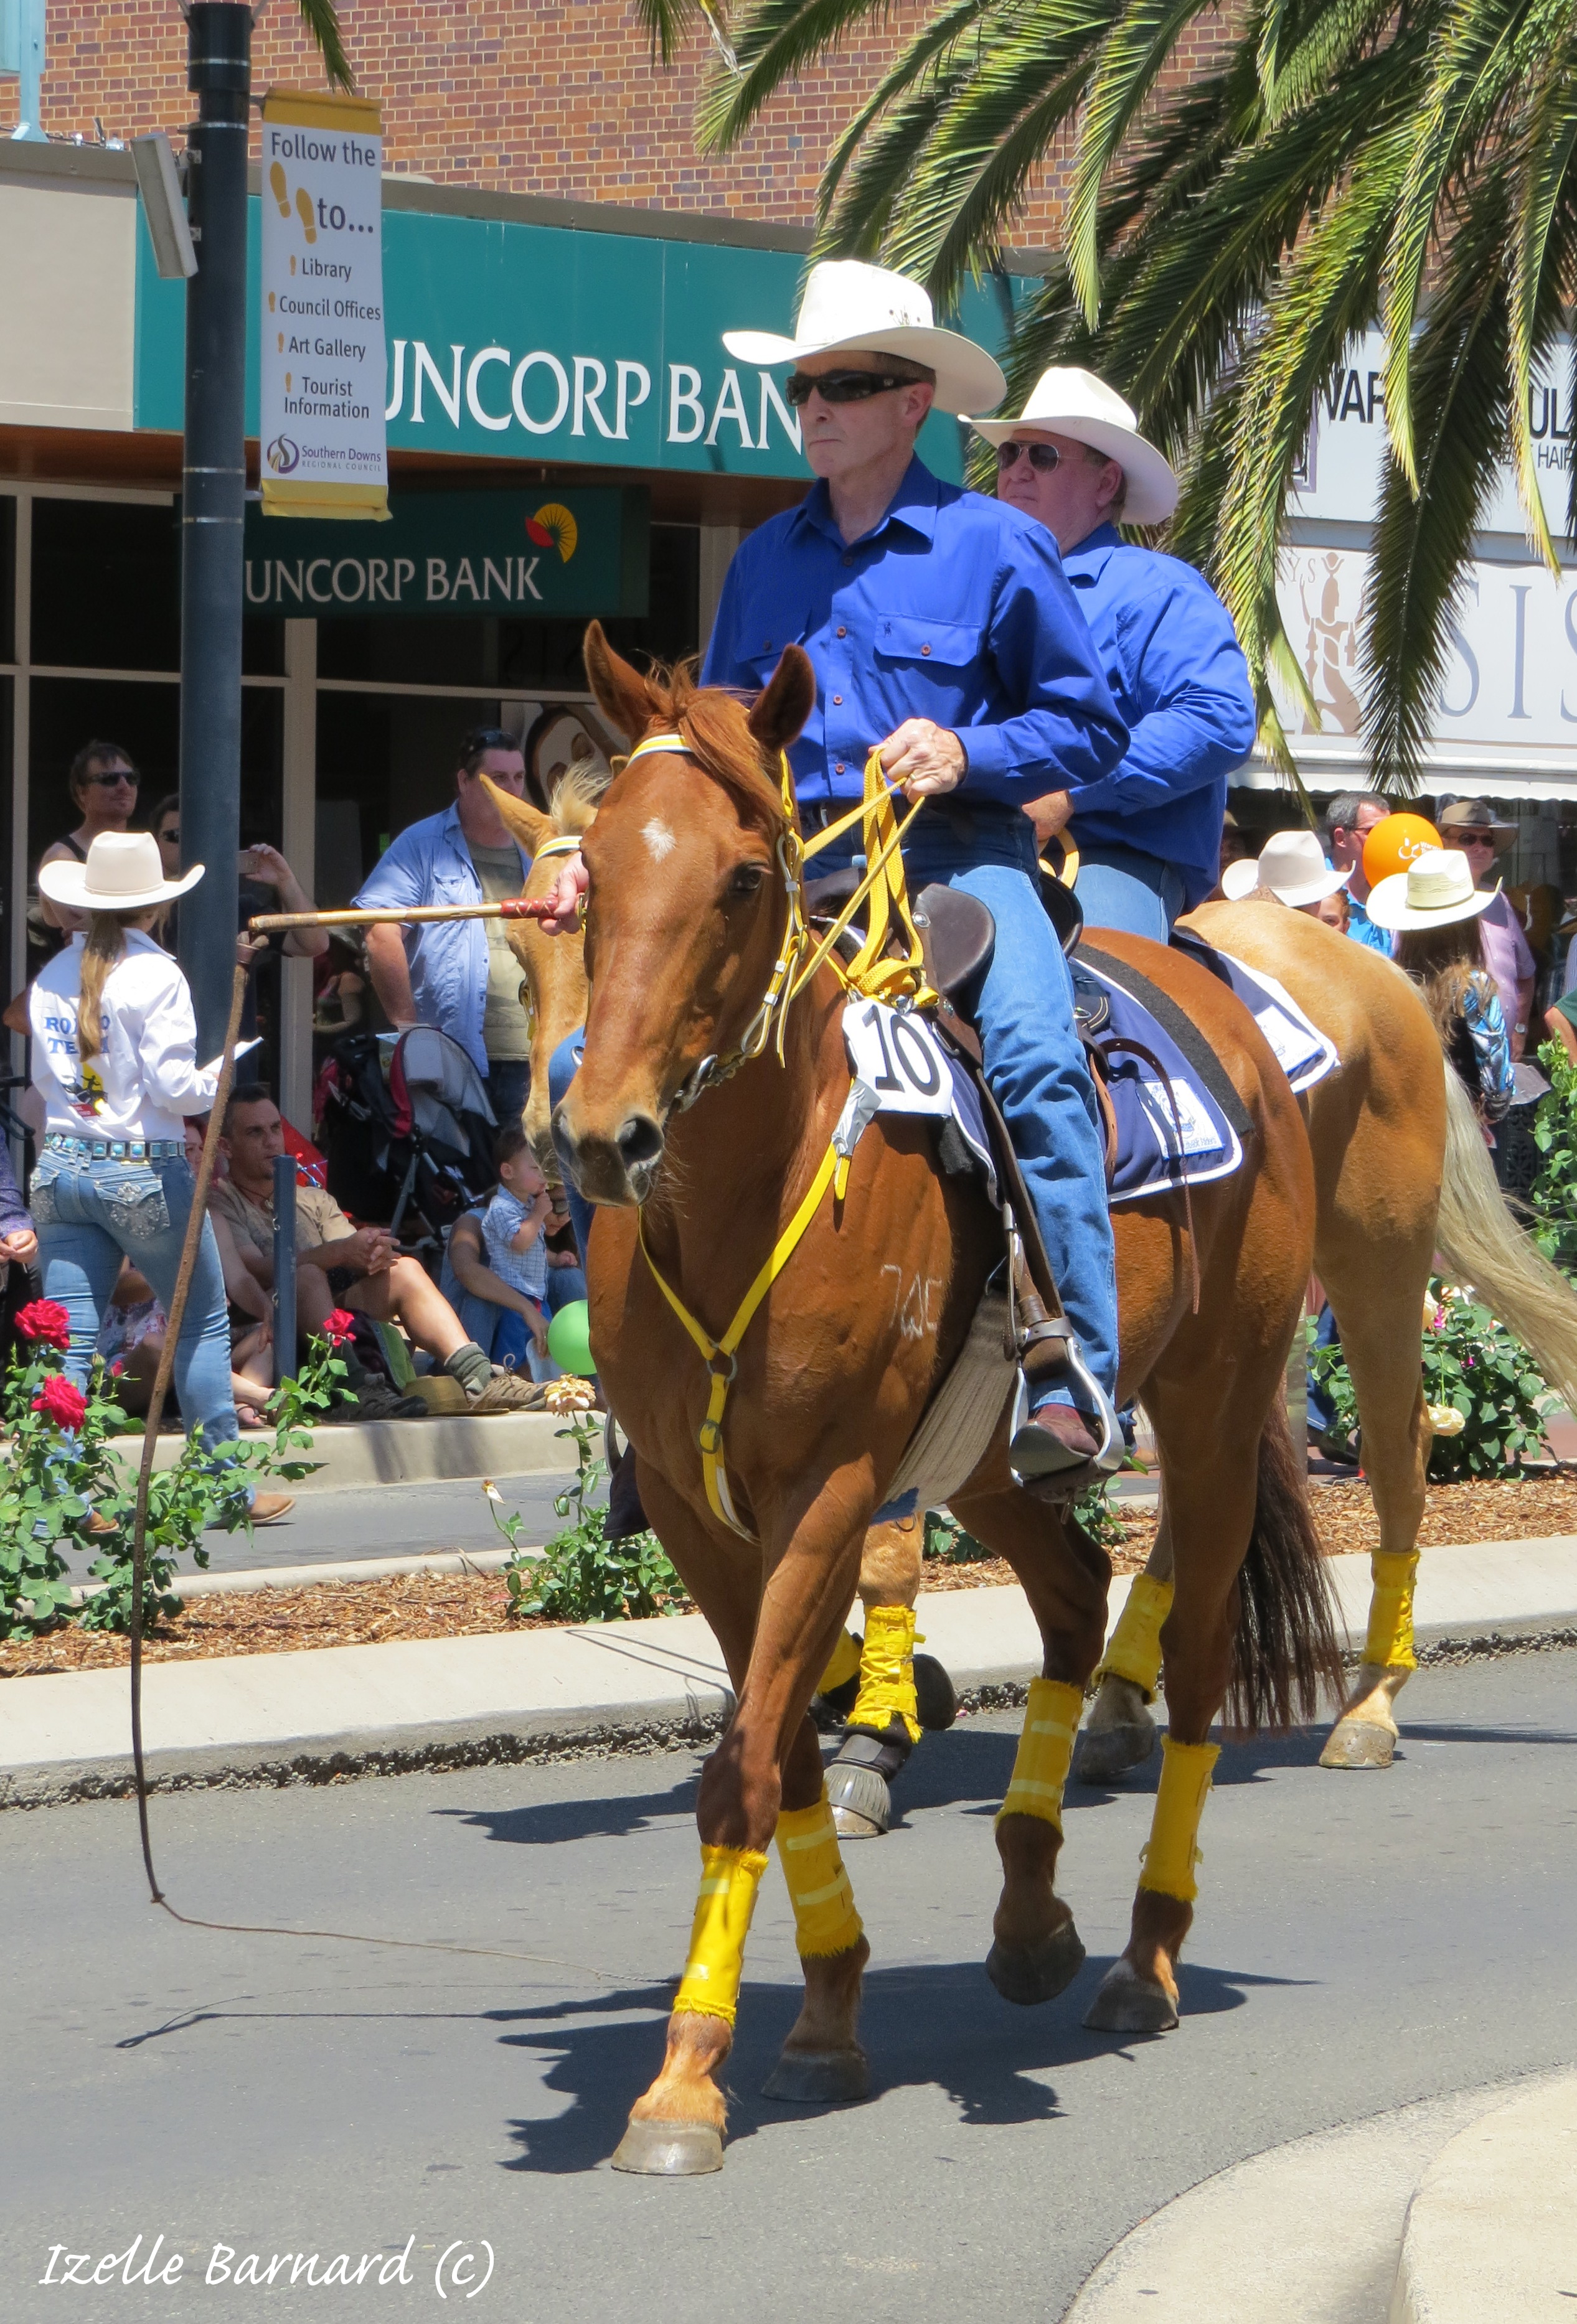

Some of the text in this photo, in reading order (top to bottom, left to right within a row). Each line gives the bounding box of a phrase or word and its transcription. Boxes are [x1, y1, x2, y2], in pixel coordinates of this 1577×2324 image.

[271, 131, 376, 167] Follow the
[318, 197, 374, 233] to...
[302, 258, 352, 283] Library
[280, 296, 381, 321] Council Offices
[288, 336, 366, 363] Art Gallery
[302, 377, 353, 397] Tourist
[285, 396, 370, 419] Information
[666, 363, 802, 456] BAN
[302, 446, 382, 462] Southern Downs
[302, 461, 381, 472] REGIONAL COUNCIL
[245, 556, 544, 604] UNCORP BANK
[862, 1004, 941, 1097] 10
